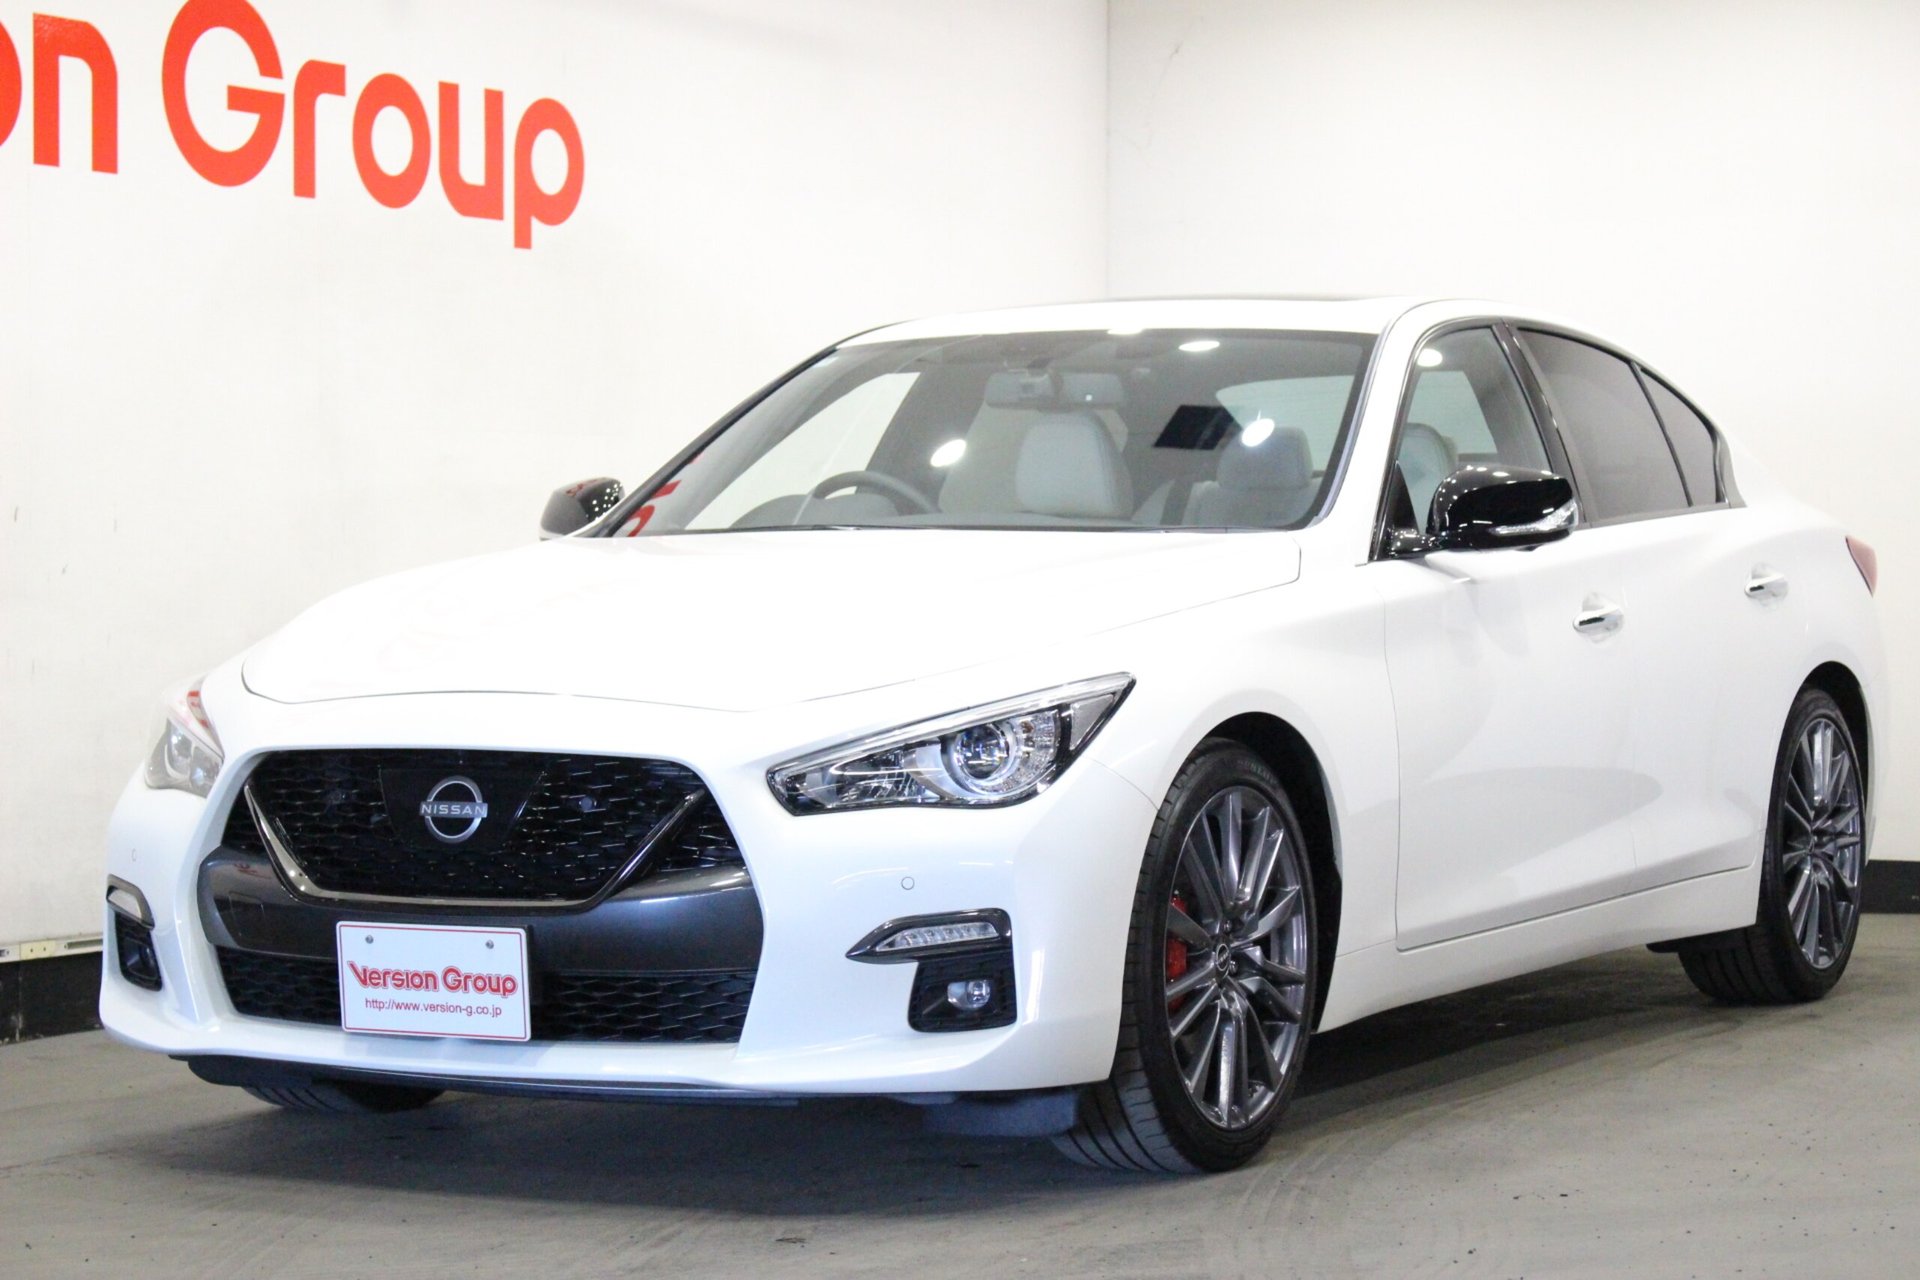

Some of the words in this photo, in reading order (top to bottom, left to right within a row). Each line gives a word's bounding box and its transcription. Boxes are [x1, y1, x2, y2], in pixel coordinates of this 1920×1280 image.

[0, 13, 118, 175] n
[161, 0, 585, 250] Group
[421, 804, 486, 815] NISSAN
[347, 960, 438, 992] Version
[442, 965, 518, 998] Group
[365, 998, 502, 1018] http://www.version-g.co.jp
